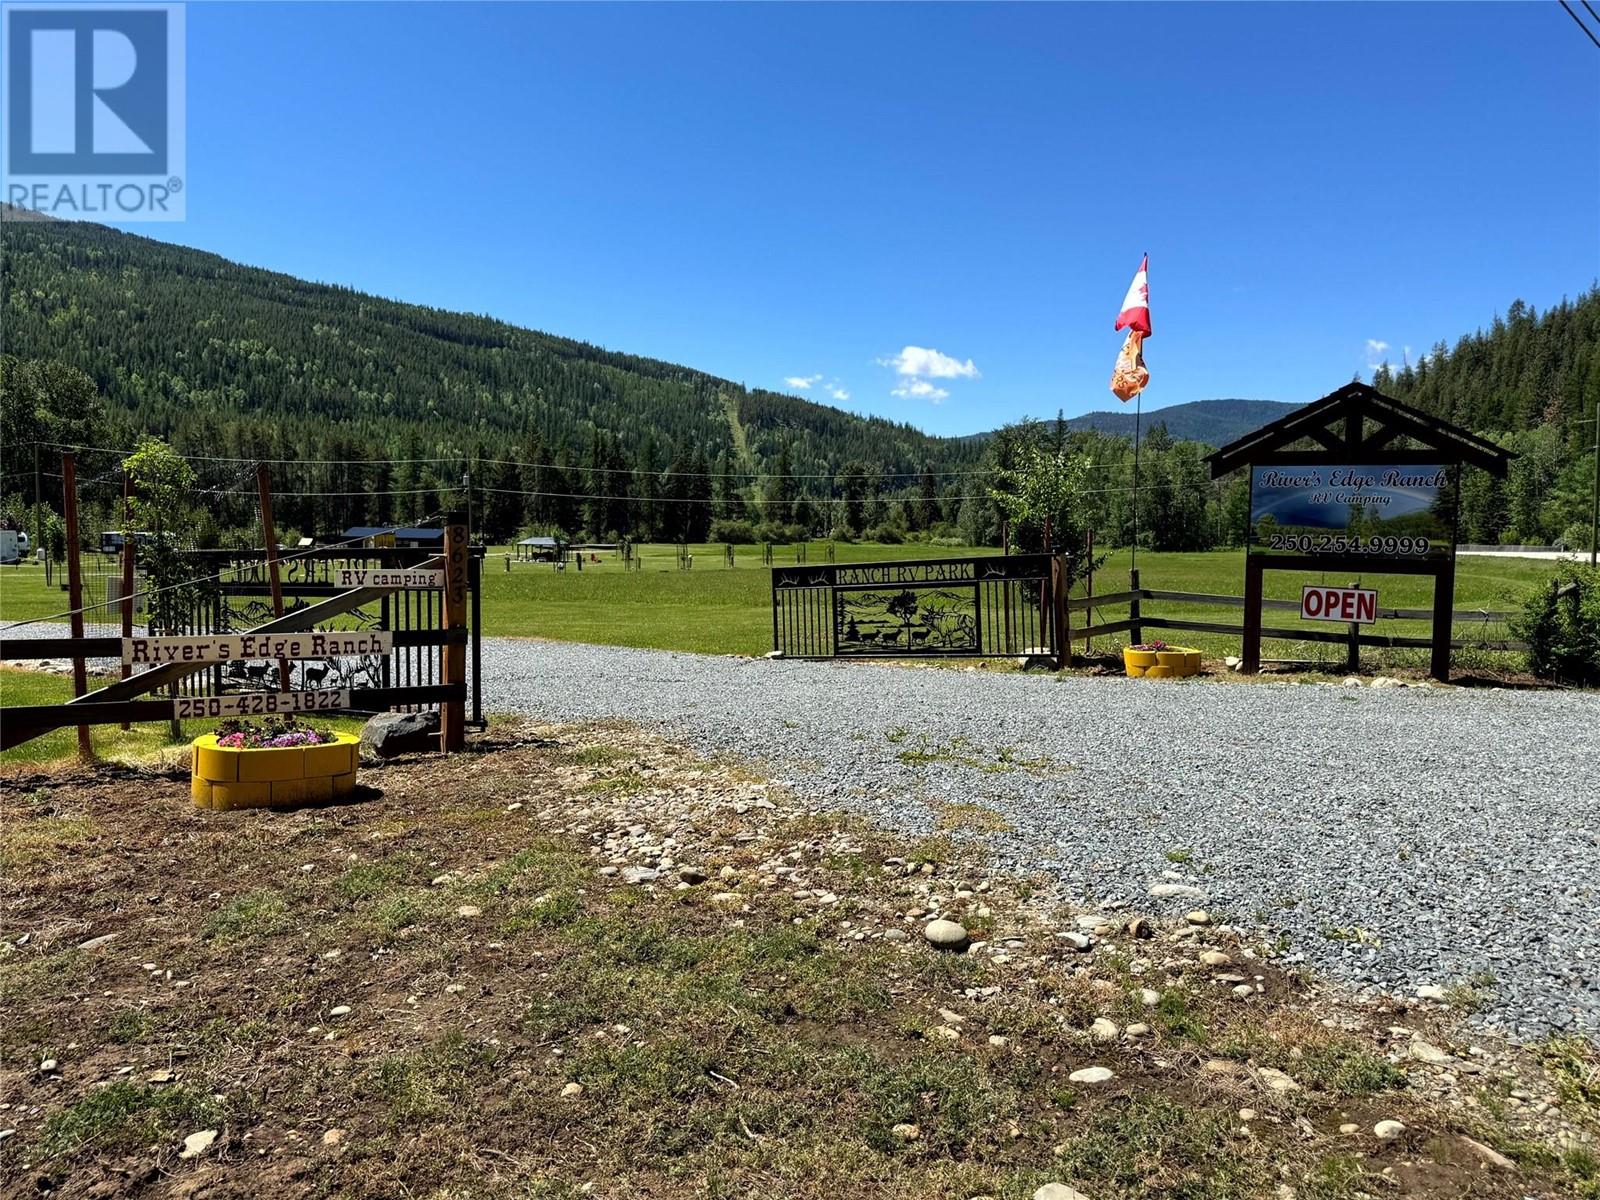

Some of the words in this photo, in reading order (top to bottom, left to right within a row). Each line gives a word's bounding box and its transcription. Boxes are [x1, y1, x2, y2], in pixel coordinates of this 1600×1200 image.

[1259, 470, 1321, 488] River's
[1329, 469, 1376, 492] Edge
[1380, 468, 1448, 488] Ranch
[1309, 492, 1333, 505] RV
[1335, 492, 1392, 508] Camping
[1270, 534, 1430, 555] 250.254.9999
[341, 570, 368, 586] RV
[373, 570, 437, 587] camping
[838, 567, 890, 585] RANCH
[898, 565, 920, 582] RV
[925, 563, 973, 581] PARK
[1304, 589, 1375, 621] OPEN
[131, 639, 230, 663] River's
[240, 636, 301, 660] Edge
[311, 634, 383, 656] Ranch
[178, 690, 342, 719] 250-428-1822
